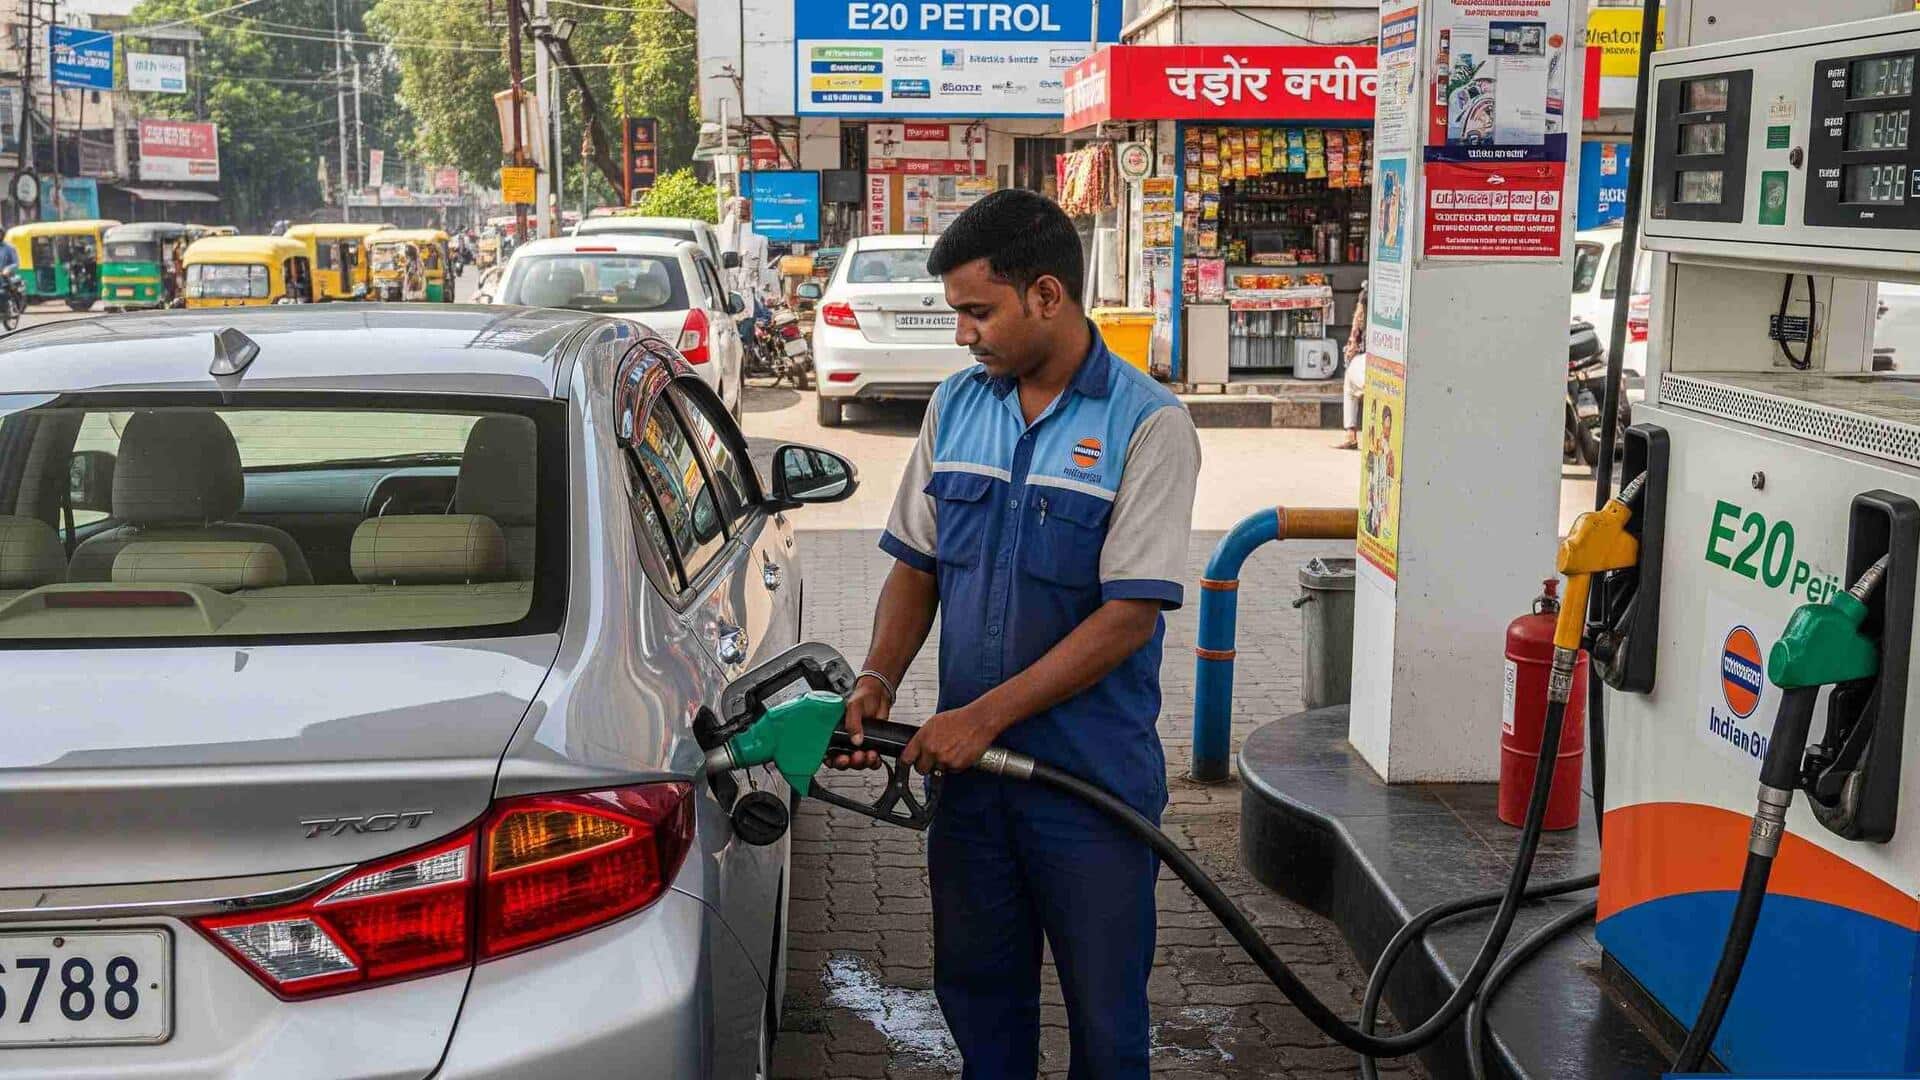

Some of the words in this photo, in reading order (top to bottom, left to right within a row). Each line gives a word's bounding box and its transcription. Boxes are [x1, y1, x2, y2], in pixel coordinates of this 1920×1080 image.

[848, 3, 909, 31] E20
[919, 3, 1062, 32] PETROL
[1705, 499, 1795, 588] E20
[0, 956, 139, 1023] 788
